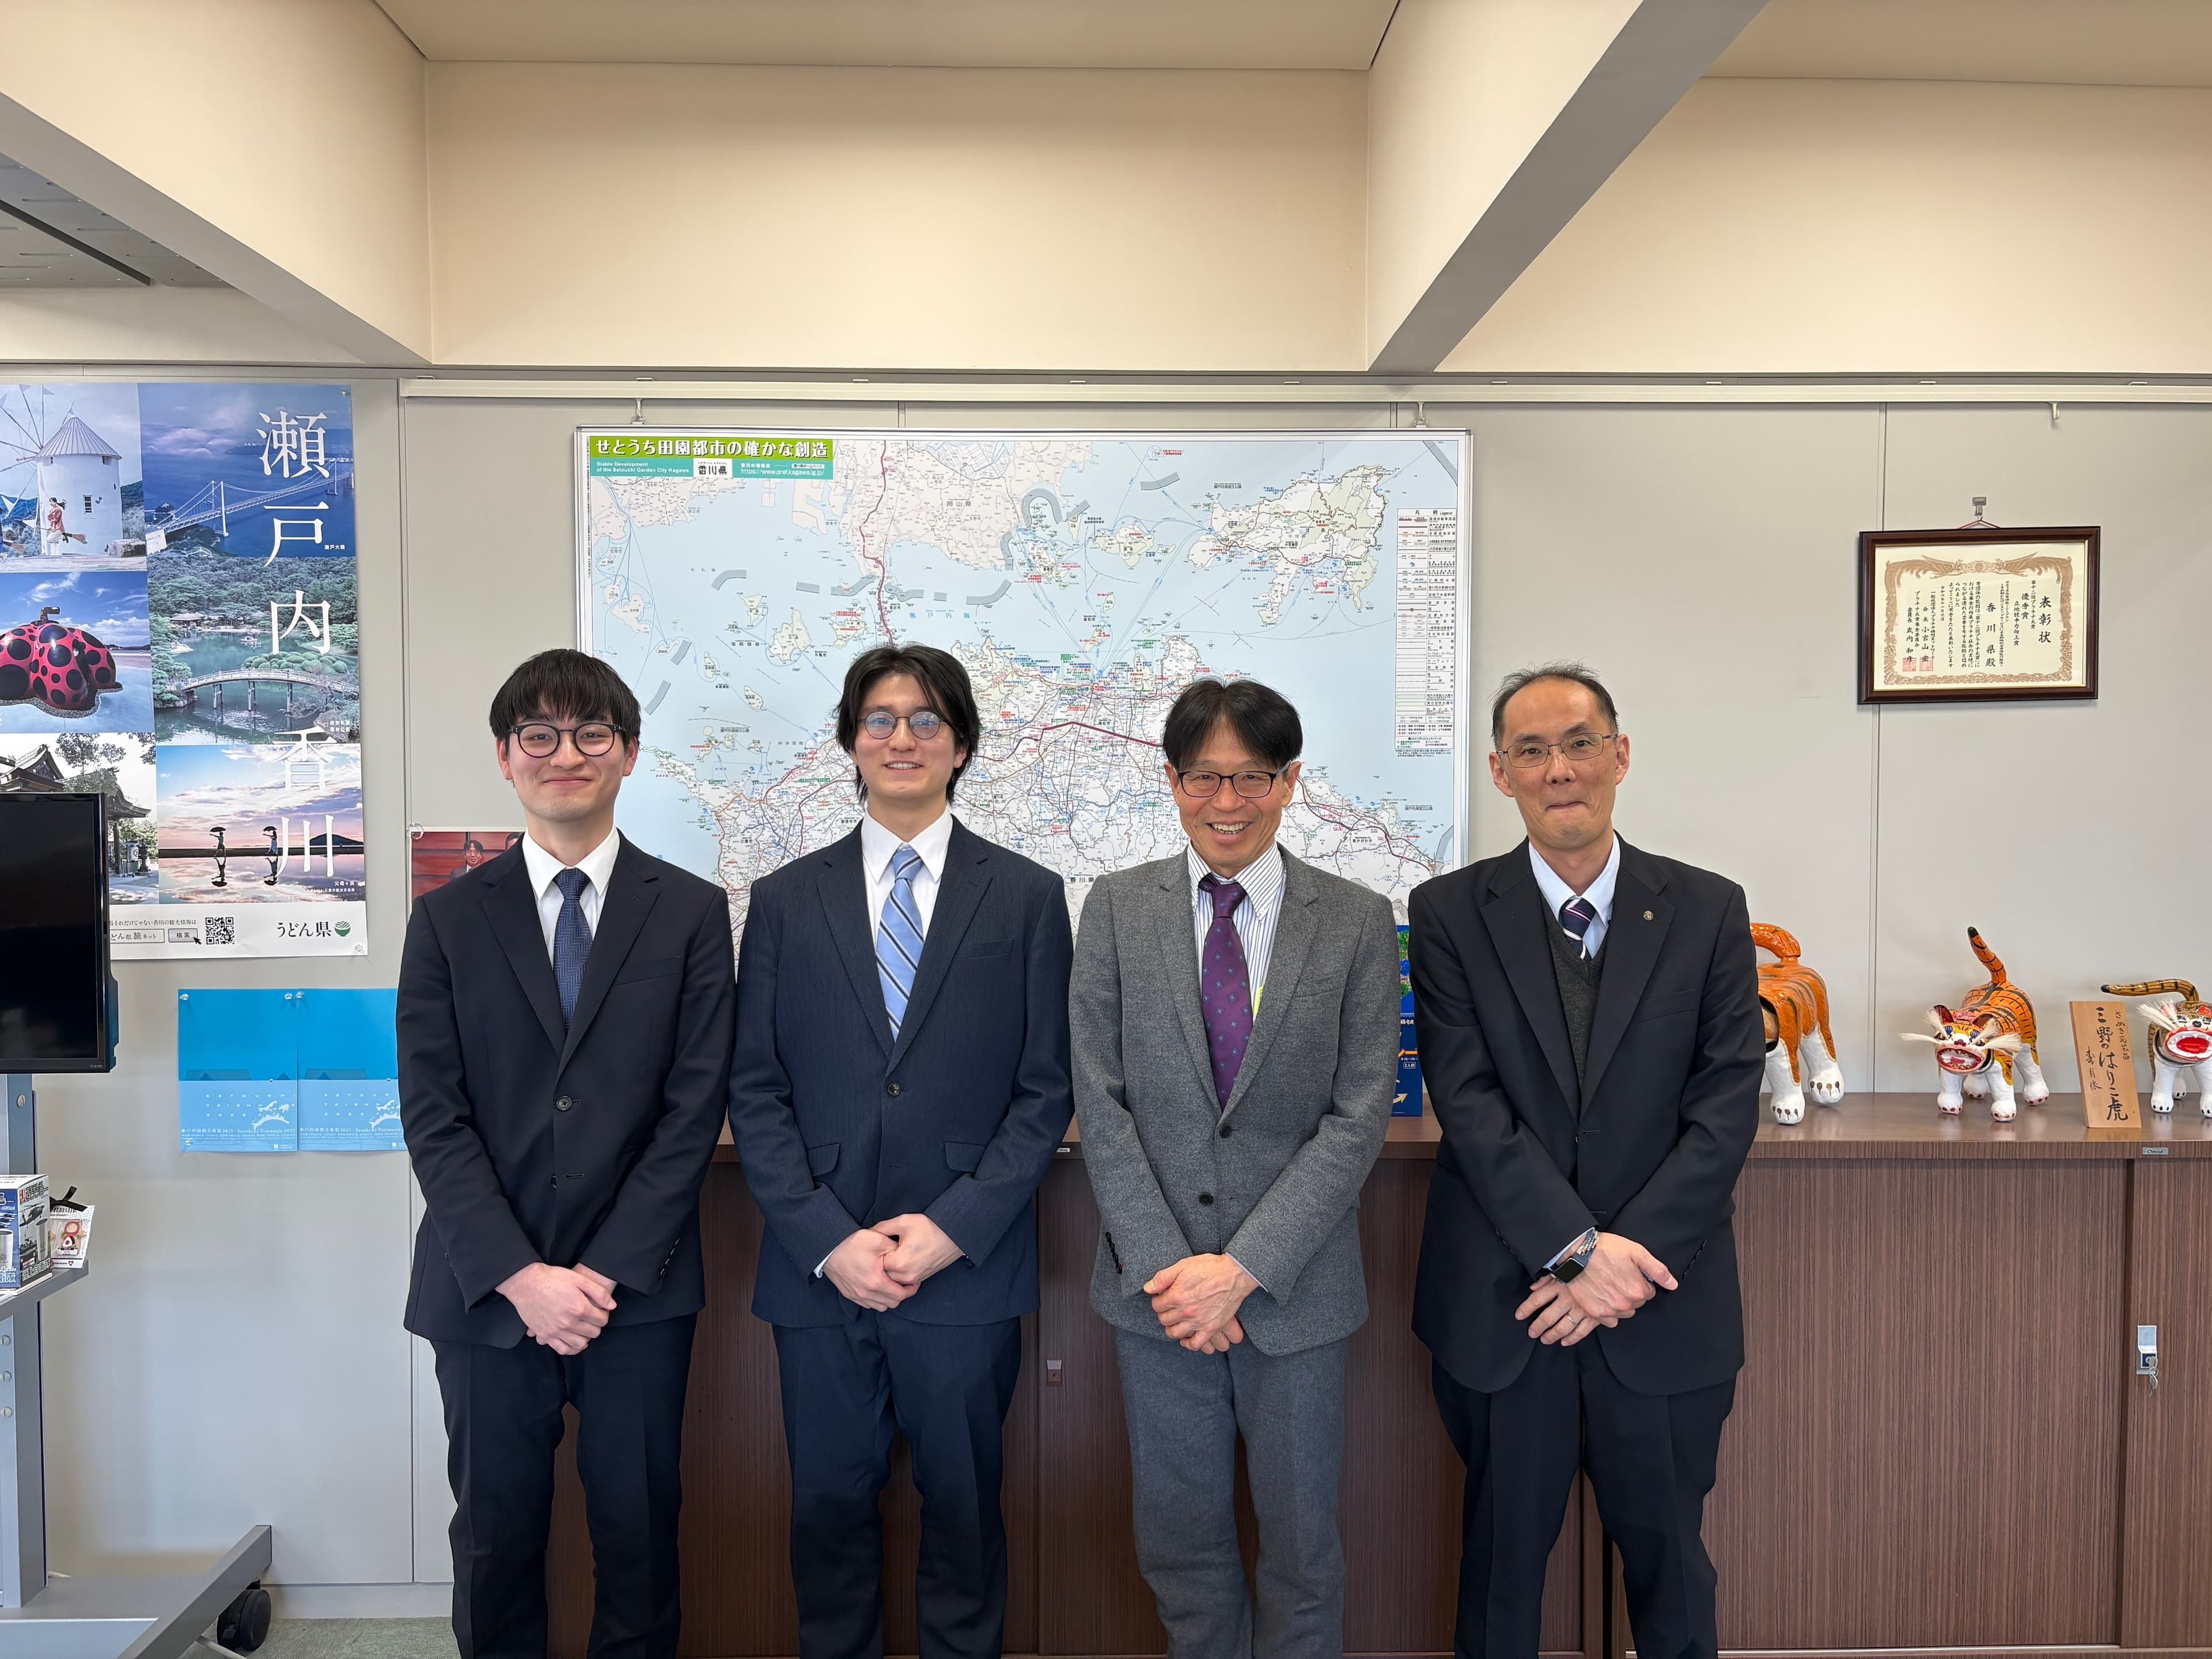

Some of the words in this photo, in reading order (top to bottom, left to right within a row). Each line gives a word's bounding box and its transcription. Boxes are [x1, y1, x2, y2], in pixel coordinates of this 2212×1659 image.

[596, 440, 828, 458] せとうち田園都市の確かな創造
[698, 465, 728, 475] 香川県
[257, 410, 331, 655] 瀬戸内
[2021, 592, 2030, 620] 優秀賞
[2038, 596, 2052, 643] 表彰状
[1985, 602, 1997, 667] 香川県殿
[276, 921, 332, 938] うどん県
